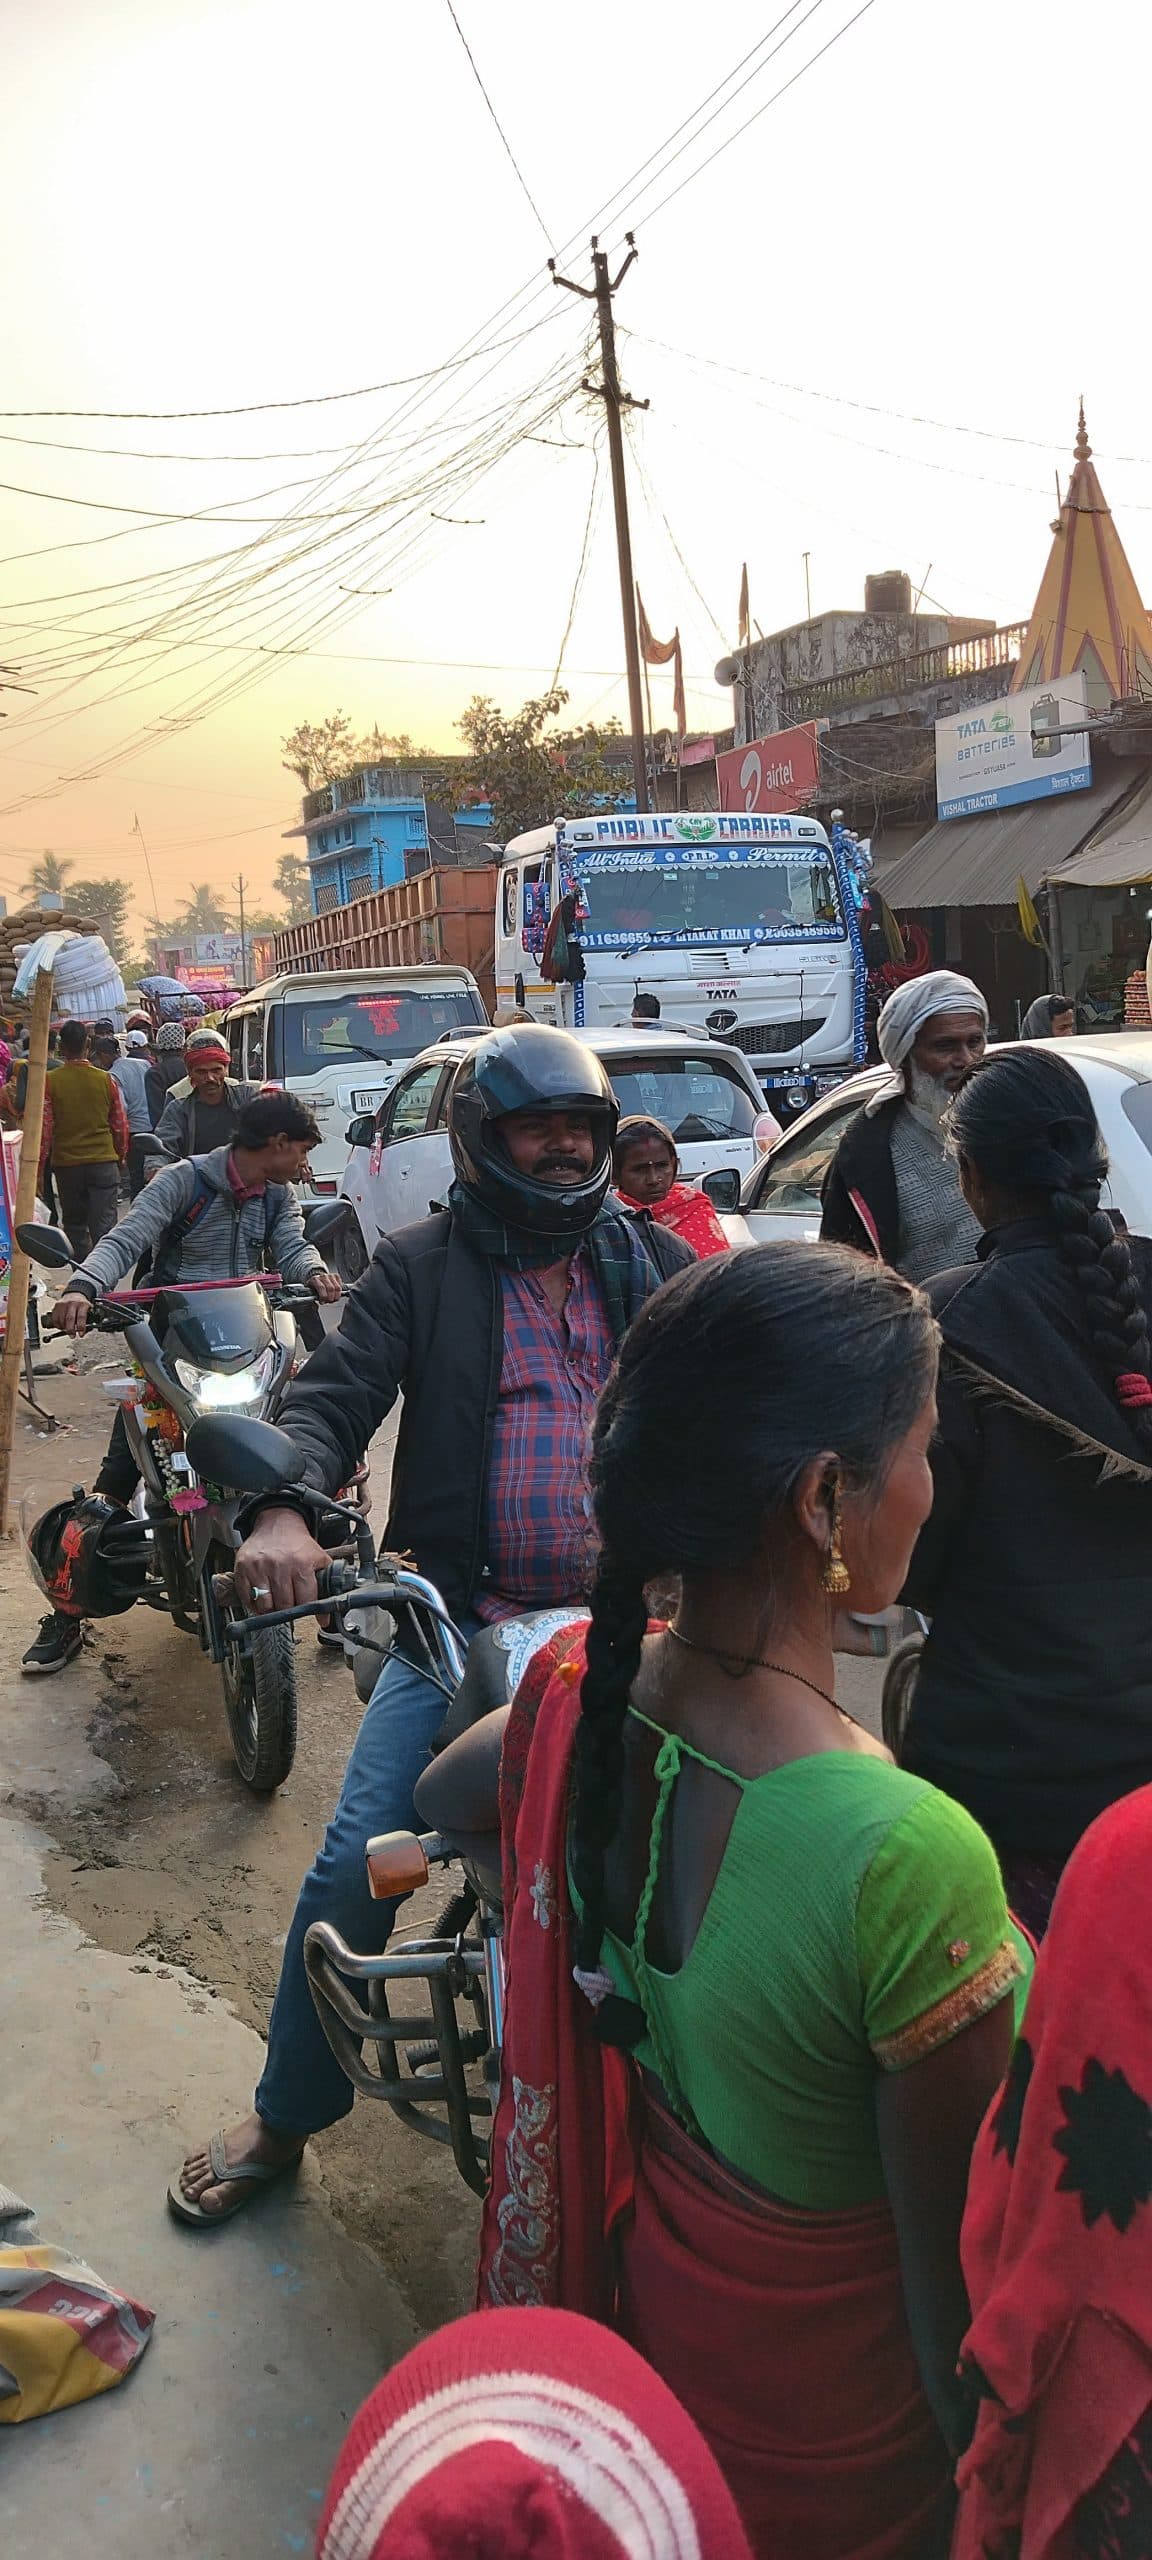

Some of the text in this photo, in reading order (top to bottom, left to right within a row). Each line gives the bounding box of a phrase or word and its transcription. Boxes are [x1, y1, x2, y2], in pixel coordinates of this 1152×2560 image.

[957, 718, 986, 739] TATA
[766, 759, 794, 790] airtel
[942, 793, 998, 816] VISHAL TRACTOR
[597, 819, 674, 841] PUBLIC
[718, 817, 793, 839] CARRIER
[608, 851, 657, 866] India
[747, 847, 818, 861] Permit
[720, 928, 751, 940] KHAN
[706, 989, 738, 999] TATA
[360, 1096, 374, 1108] BR
[210, 1344, 242, 1352] HONDA
